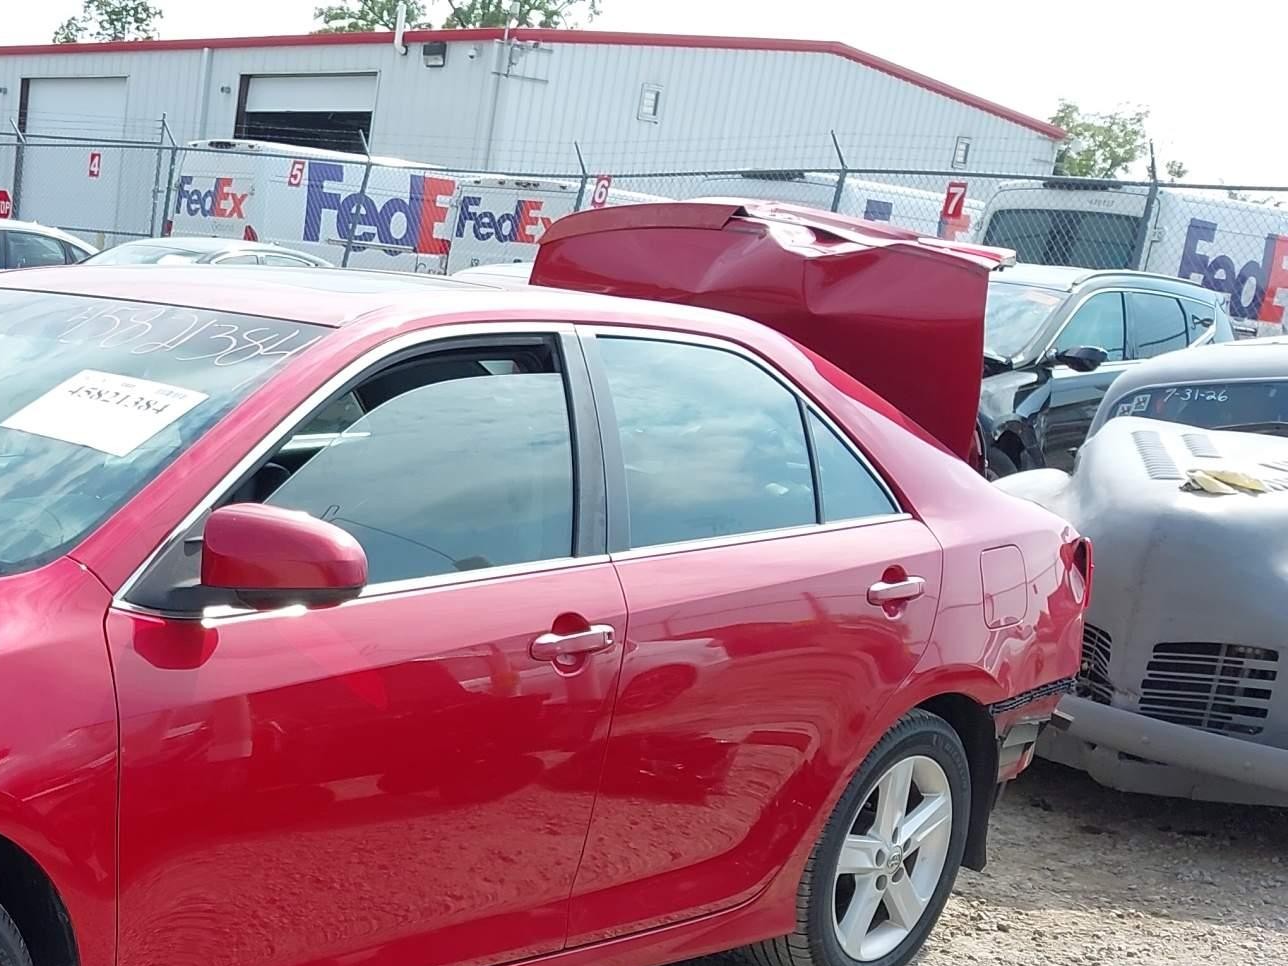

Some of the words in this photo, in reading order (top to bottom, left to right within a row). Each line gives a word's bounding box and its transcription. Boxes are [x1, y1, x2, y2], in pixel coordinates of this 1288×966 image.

[90, 155, 99, 176] 4
[290, 162, 304, 185] 5
[176, 175, 249, 219] FedEx
[594, 179, 609, 204] 6
[948, 187, 965, 215] 7
[455, 195, 554, 244] FedE
[67, 384, 171, 415] 45821384
[1163, 388, 1229, 402] 7-31-26
